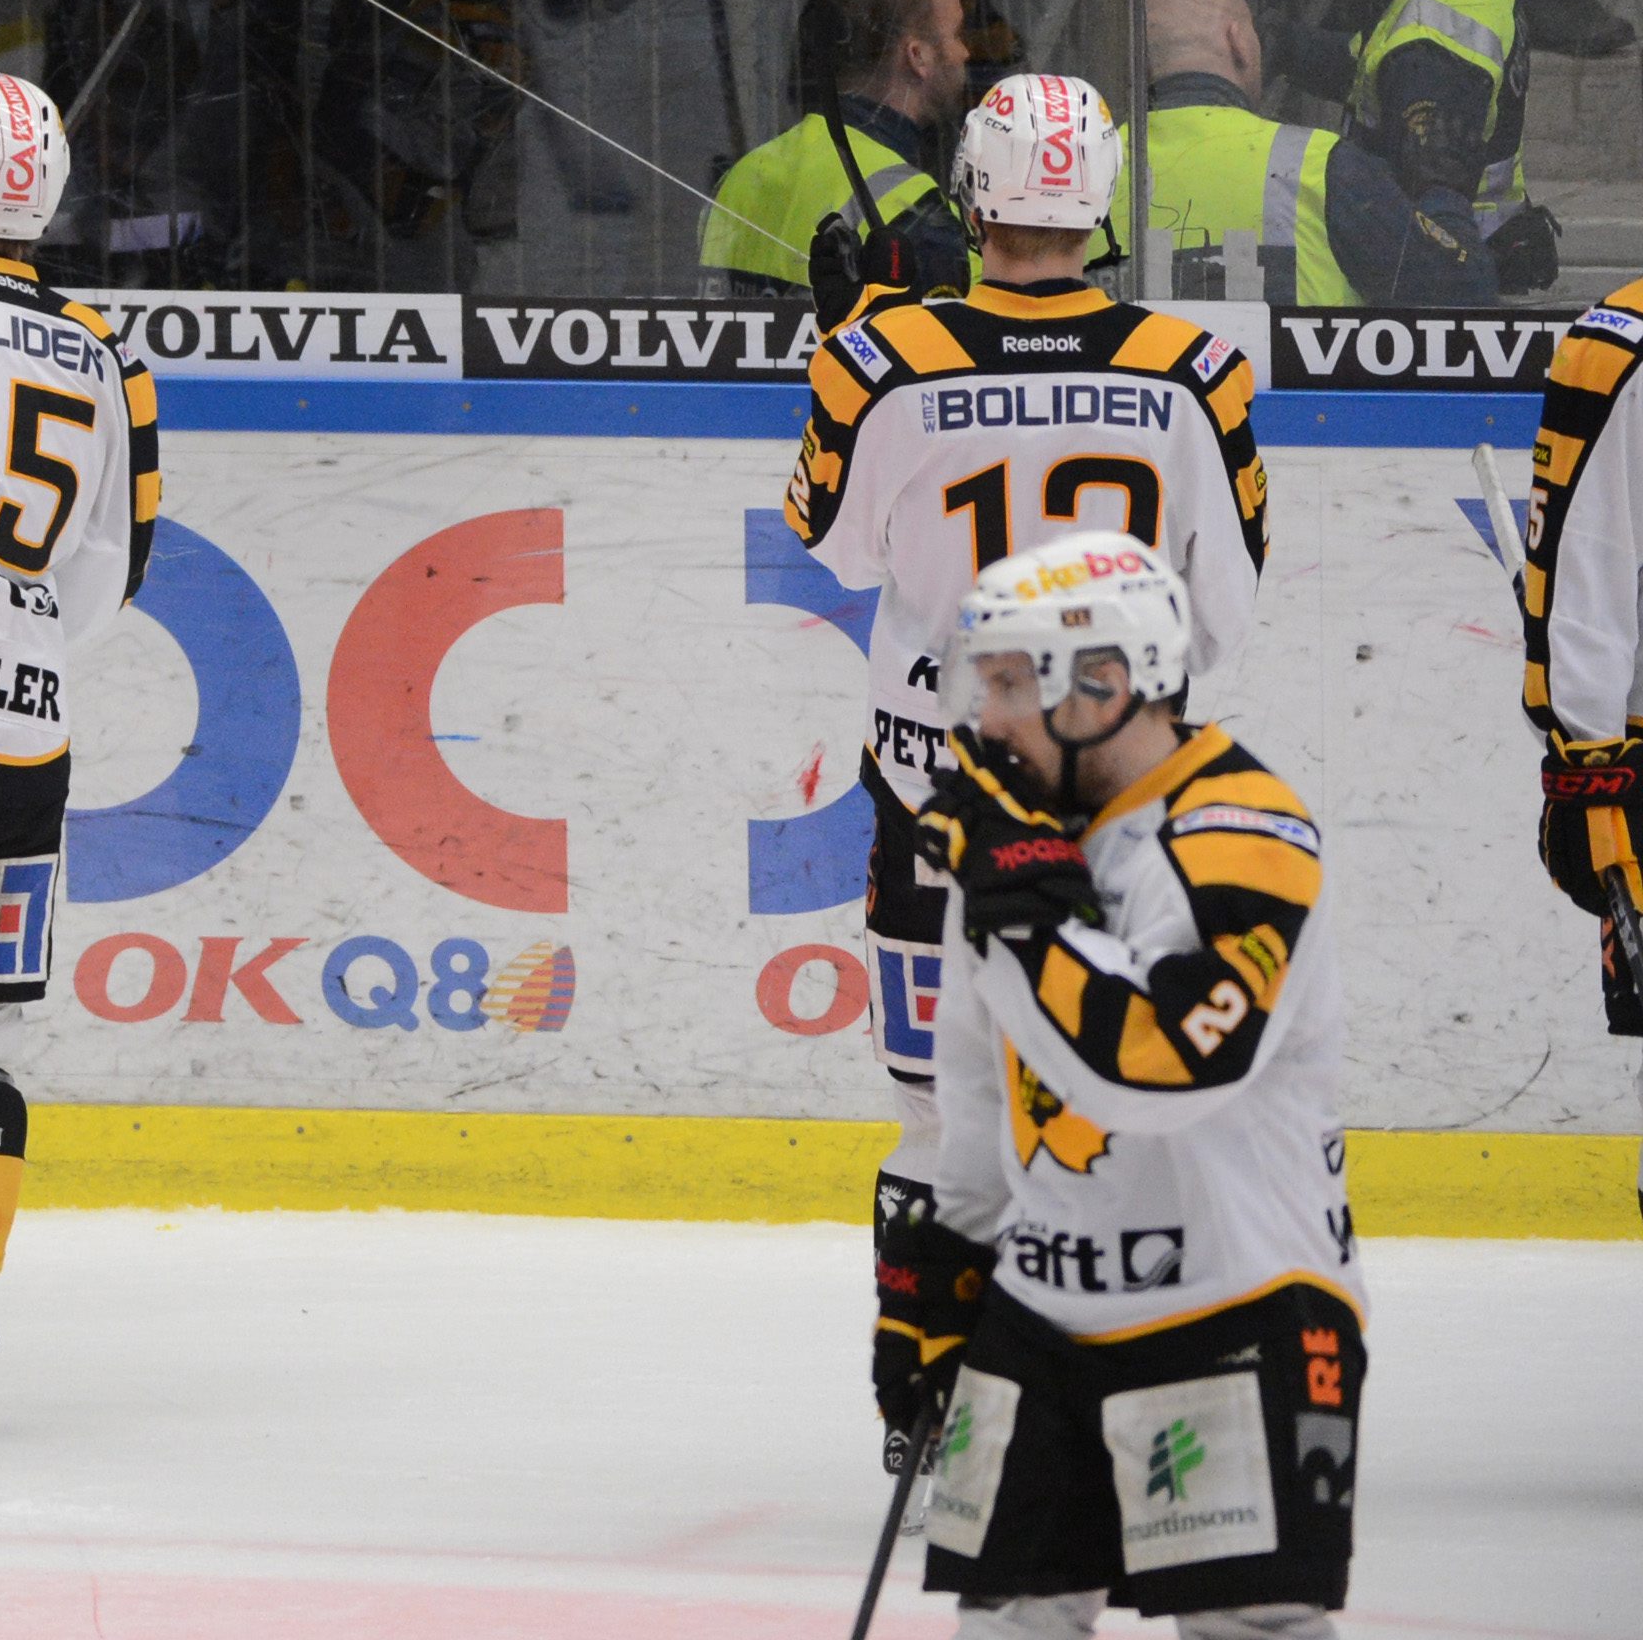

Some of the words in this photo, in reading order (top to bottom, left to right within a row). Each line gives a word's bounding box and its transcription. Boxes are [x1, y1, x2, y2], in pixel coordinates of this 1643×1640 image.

[984, 116, 1013, 134] CCM
[2, 144, 37, 202] ICA
[977, 168, 990, 193] 12
[1041, 125, 1075, 187] ICA
[85, 303, 446, 363] VOLVIA
[475, 307, 820, 369] VOLVIA
[1002, 334, 1082, 354] Reebok
[1585, 307, 1632, 331] SPORT
[843, 329, 878, 367] SPORT
[921, 391, 936, 434] NEW
[937, 384, 1173, 433] BOLIDEN
[755, 943, 871, 1037] O
[1179, 978, 1250, 1059] 2
